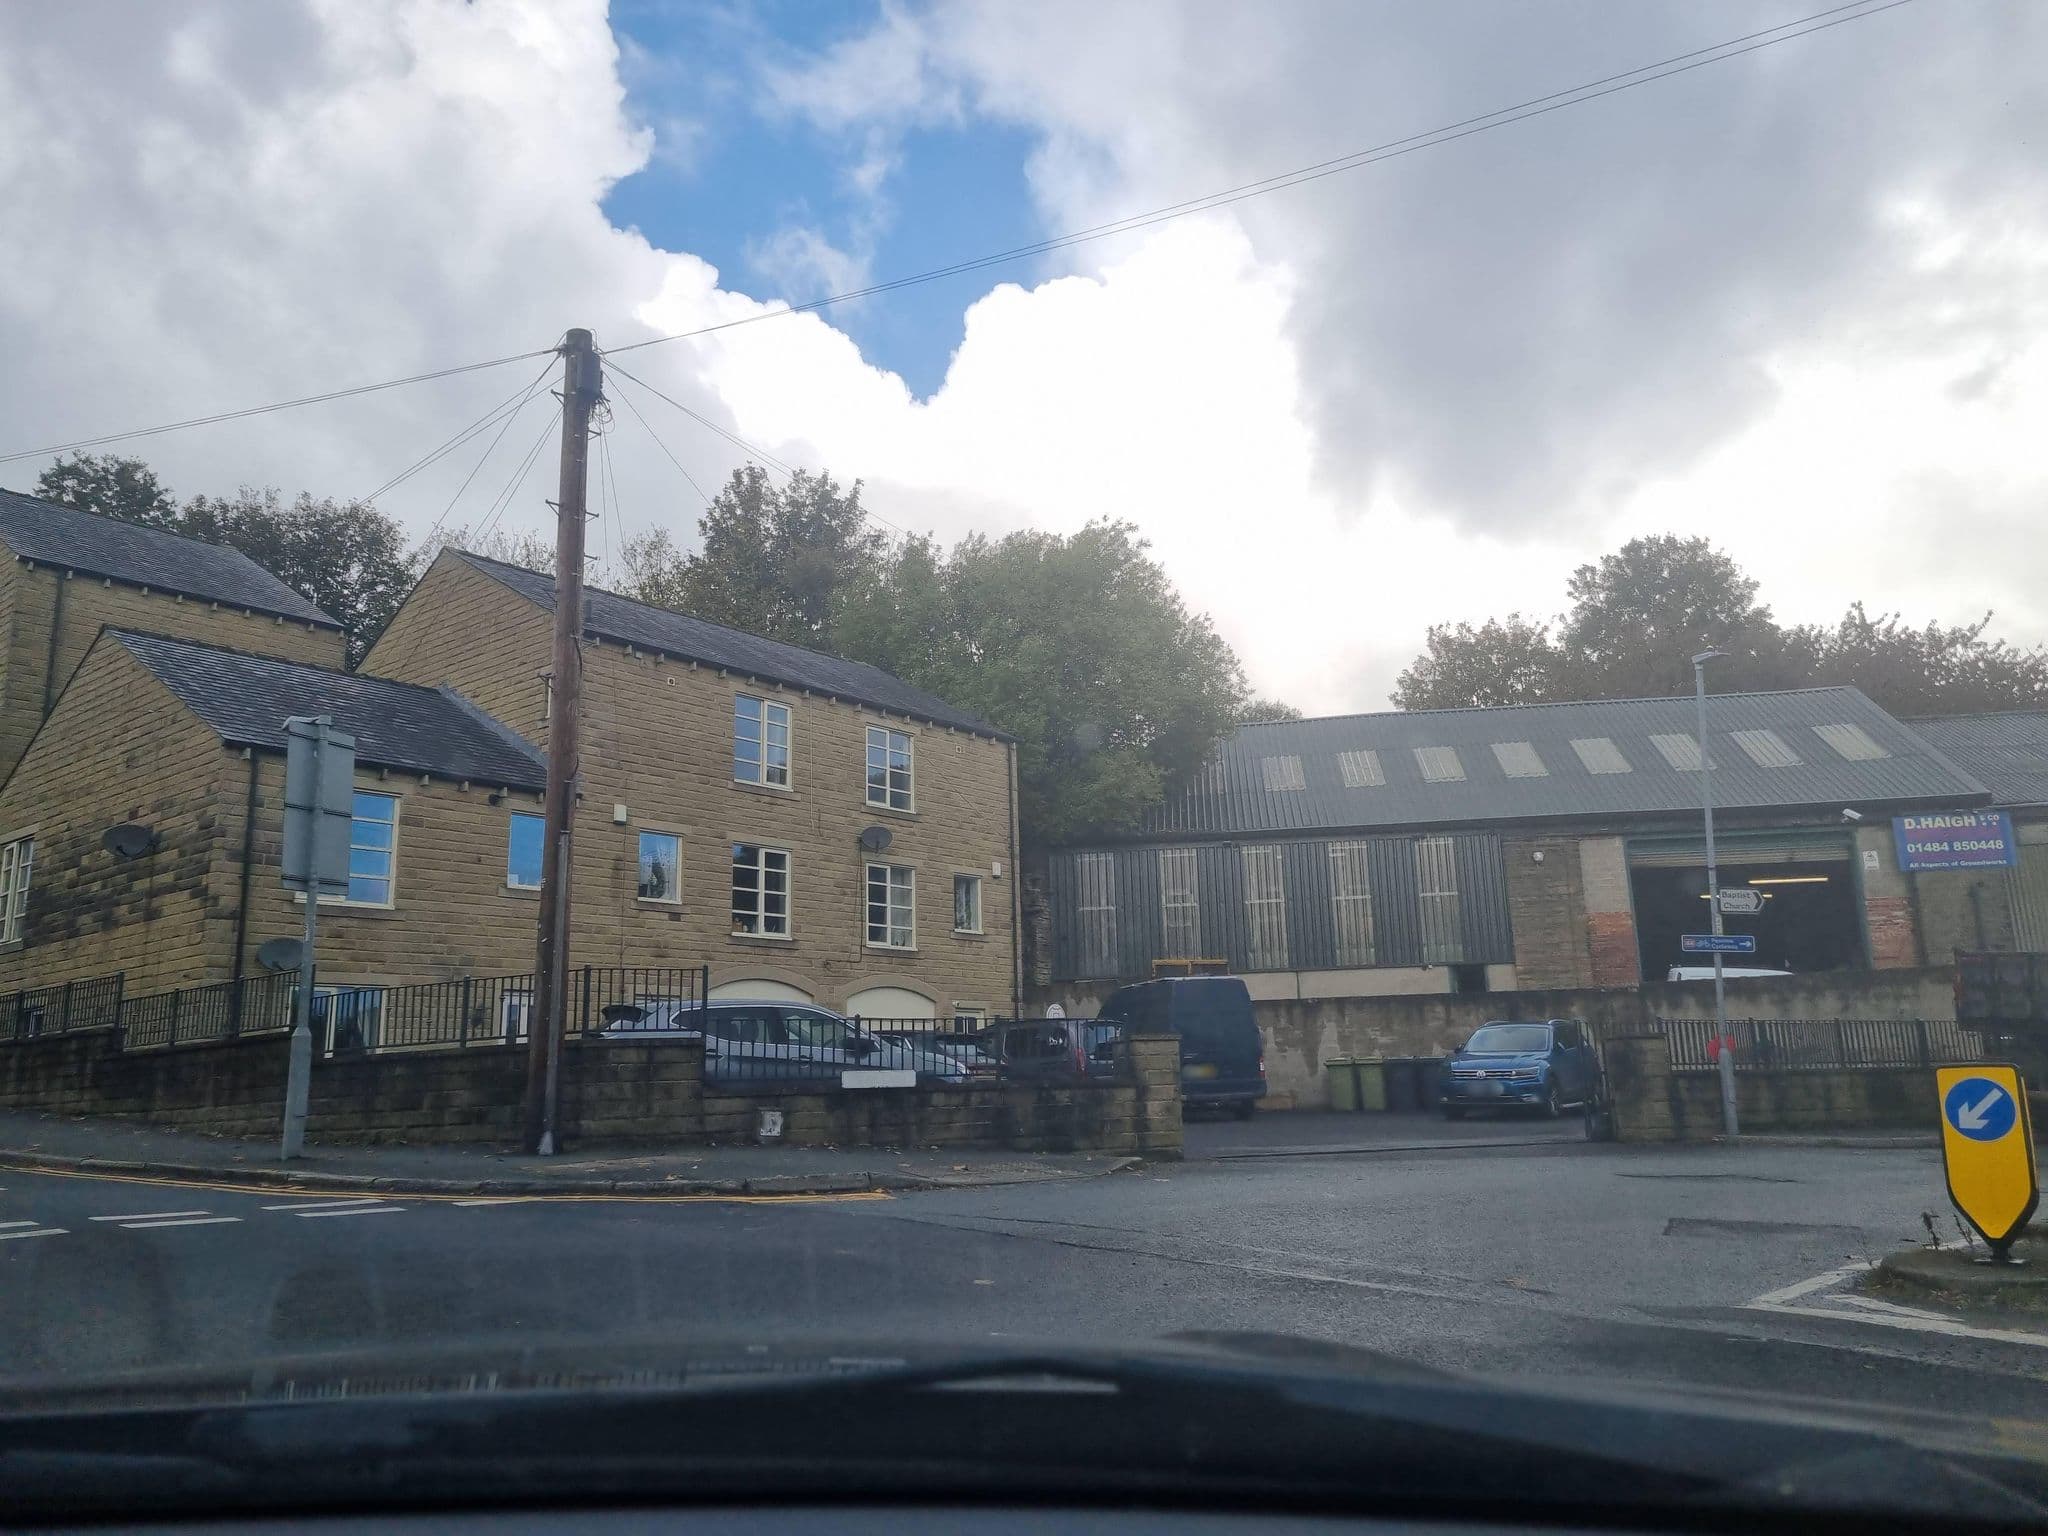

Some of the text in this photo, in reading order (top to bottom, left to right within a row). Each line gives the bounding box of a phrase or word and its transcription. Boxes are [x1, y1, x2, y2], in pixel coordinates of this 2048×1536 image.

[1903, 815, 1977, 829] D.HAIGH
[1907, 840, 2004, 853] 01484 850448
[1722, 891, 1752, 900] Baptist
